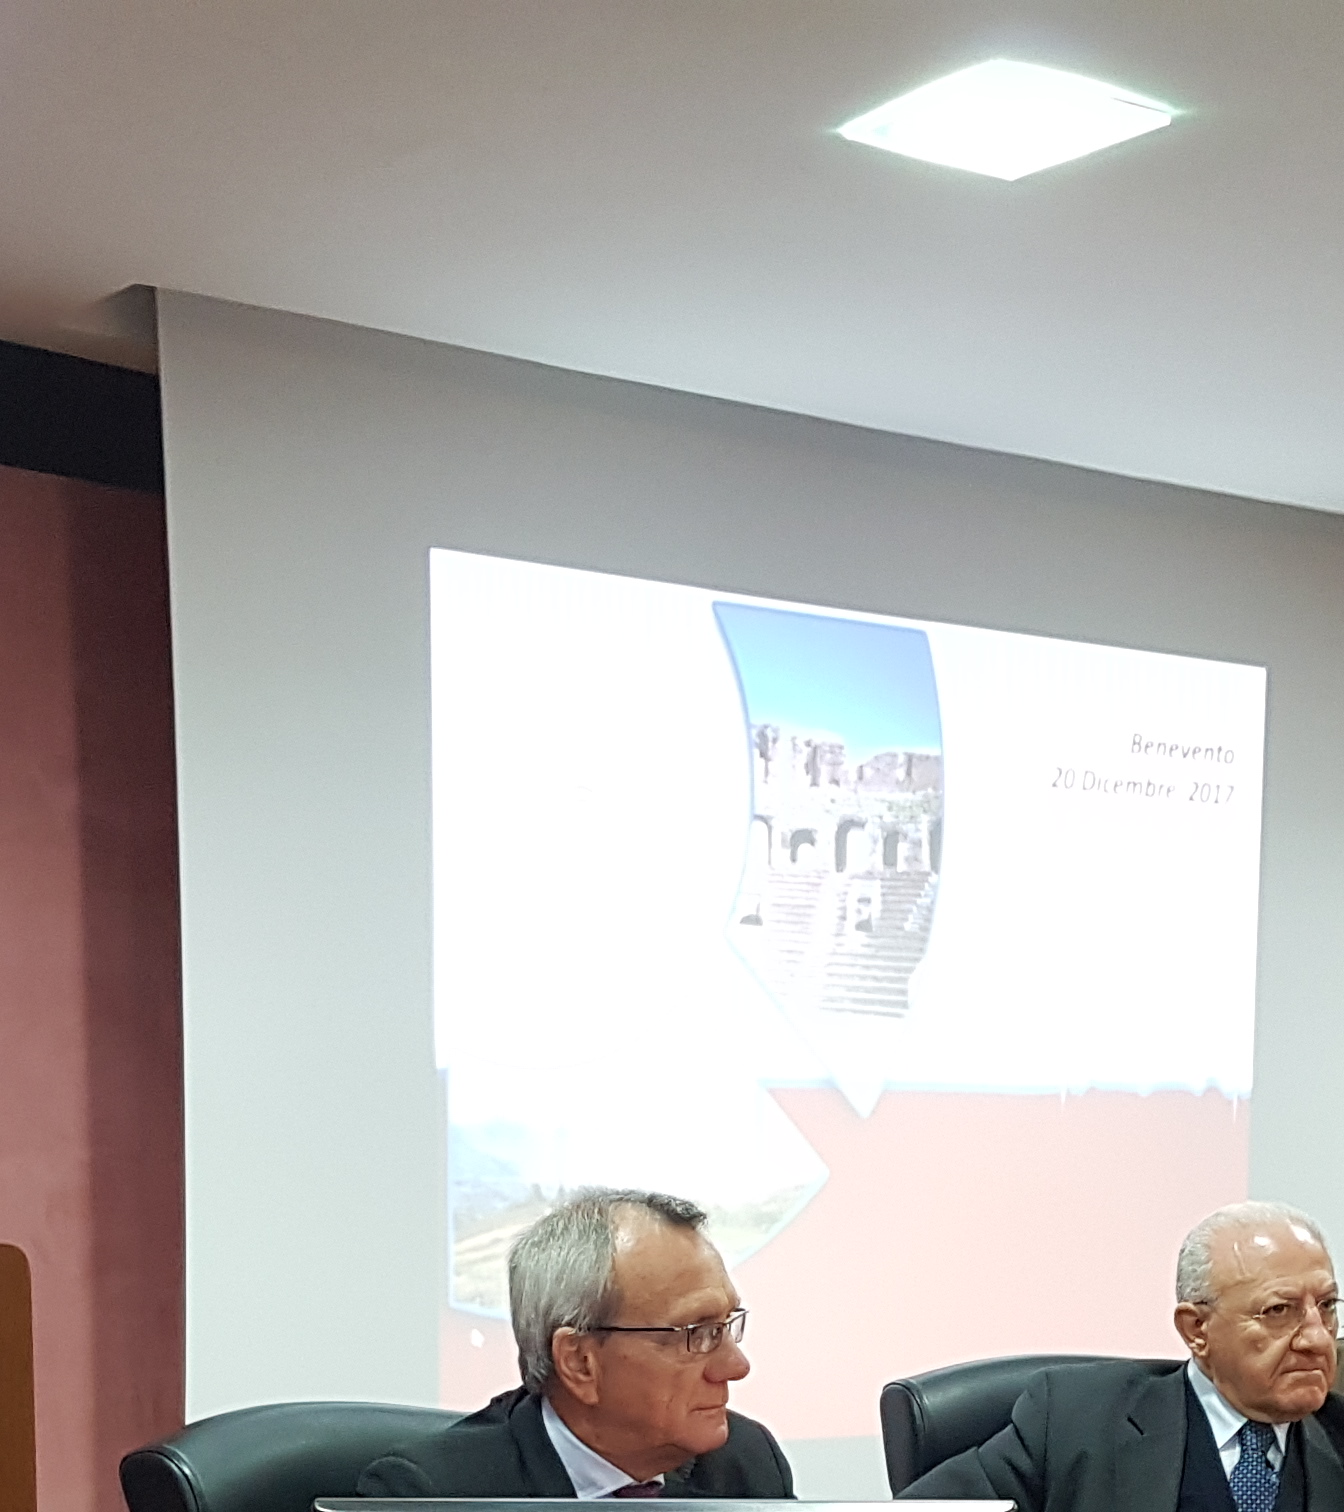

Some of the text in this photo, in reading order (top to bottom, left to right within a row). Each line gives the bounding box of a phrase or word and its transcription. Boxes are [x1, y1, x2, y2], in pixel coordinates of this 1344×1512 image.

[1130, 732, 1235, 765] Benevento
[1051, 766, 1235, 805] 20 Dicembre 2017
